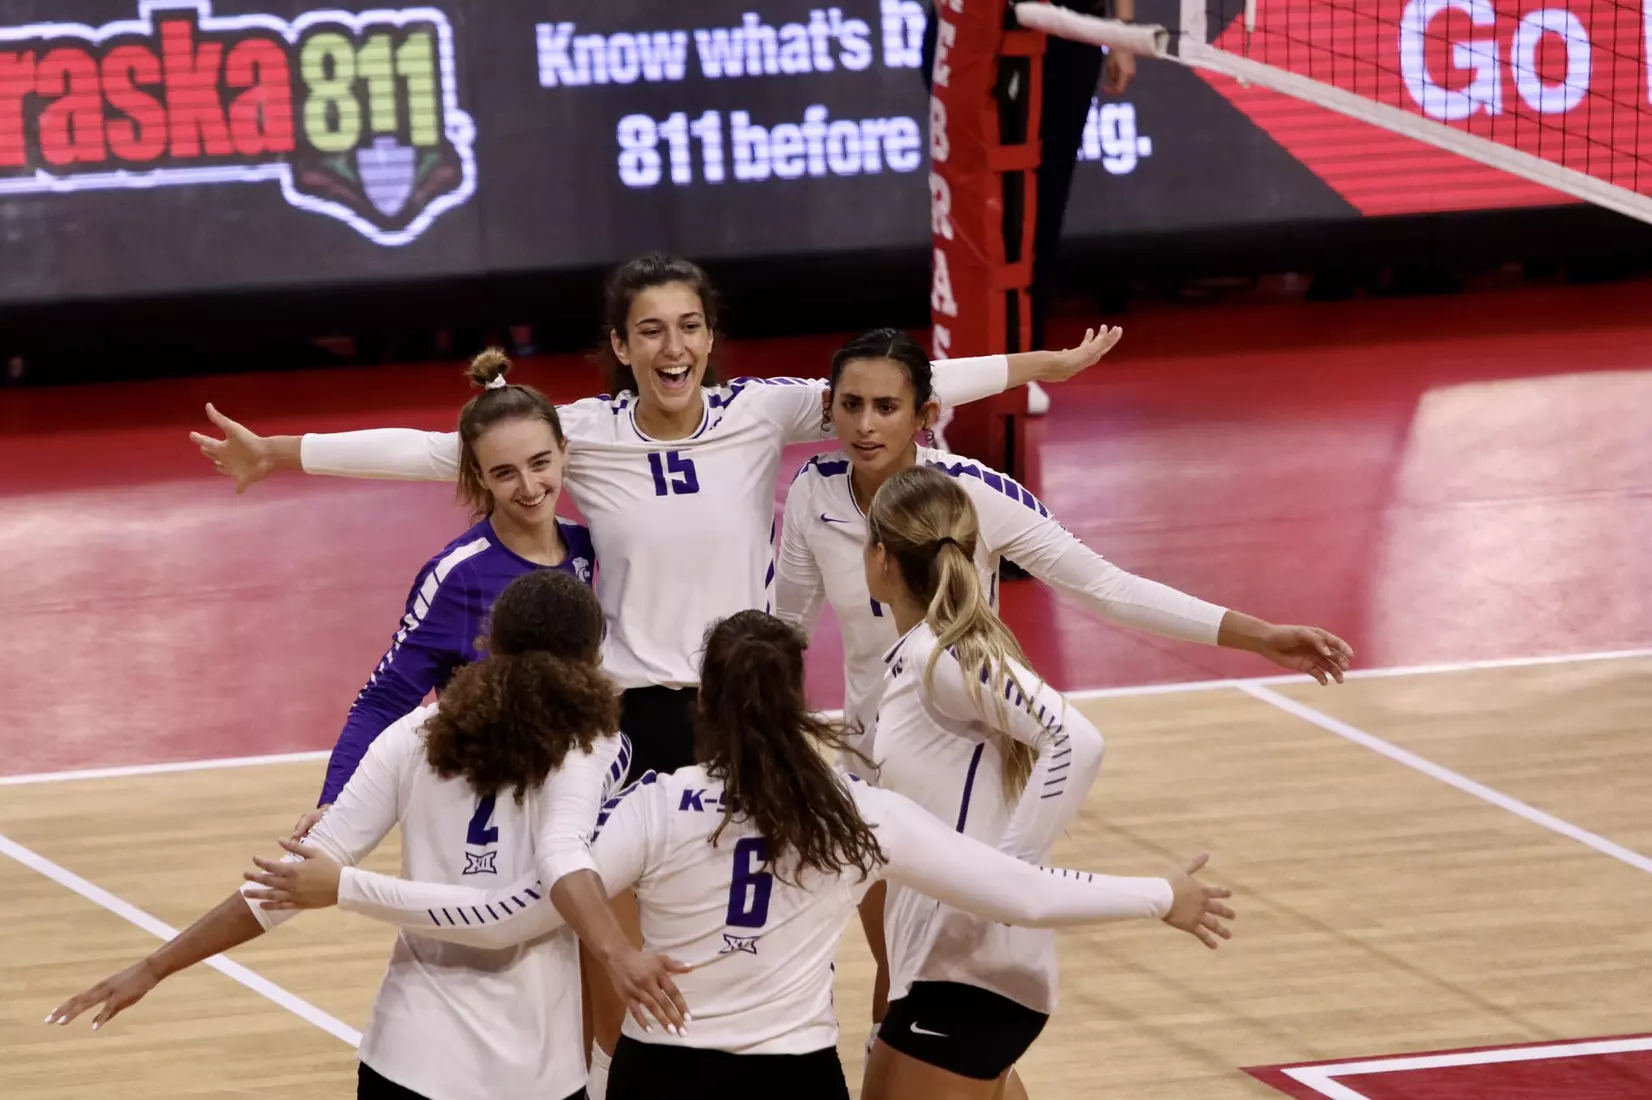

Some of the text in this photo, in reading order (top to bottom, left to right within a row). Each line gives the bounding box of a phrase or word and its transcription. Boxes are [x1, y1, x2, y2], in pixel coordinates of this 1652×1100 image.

[301, 32, 438, 151] 811
[535, 23, 688, 87] Know
[694, 8, 872, 77] what's
[1398, 0, 1593, 120] Go
[617, 96, 1152, 187] 811 before ig.
[648, 451, 700, 496] 15
[466, 794, 499, 846] 2
[725, 837, 774, 928] 6
